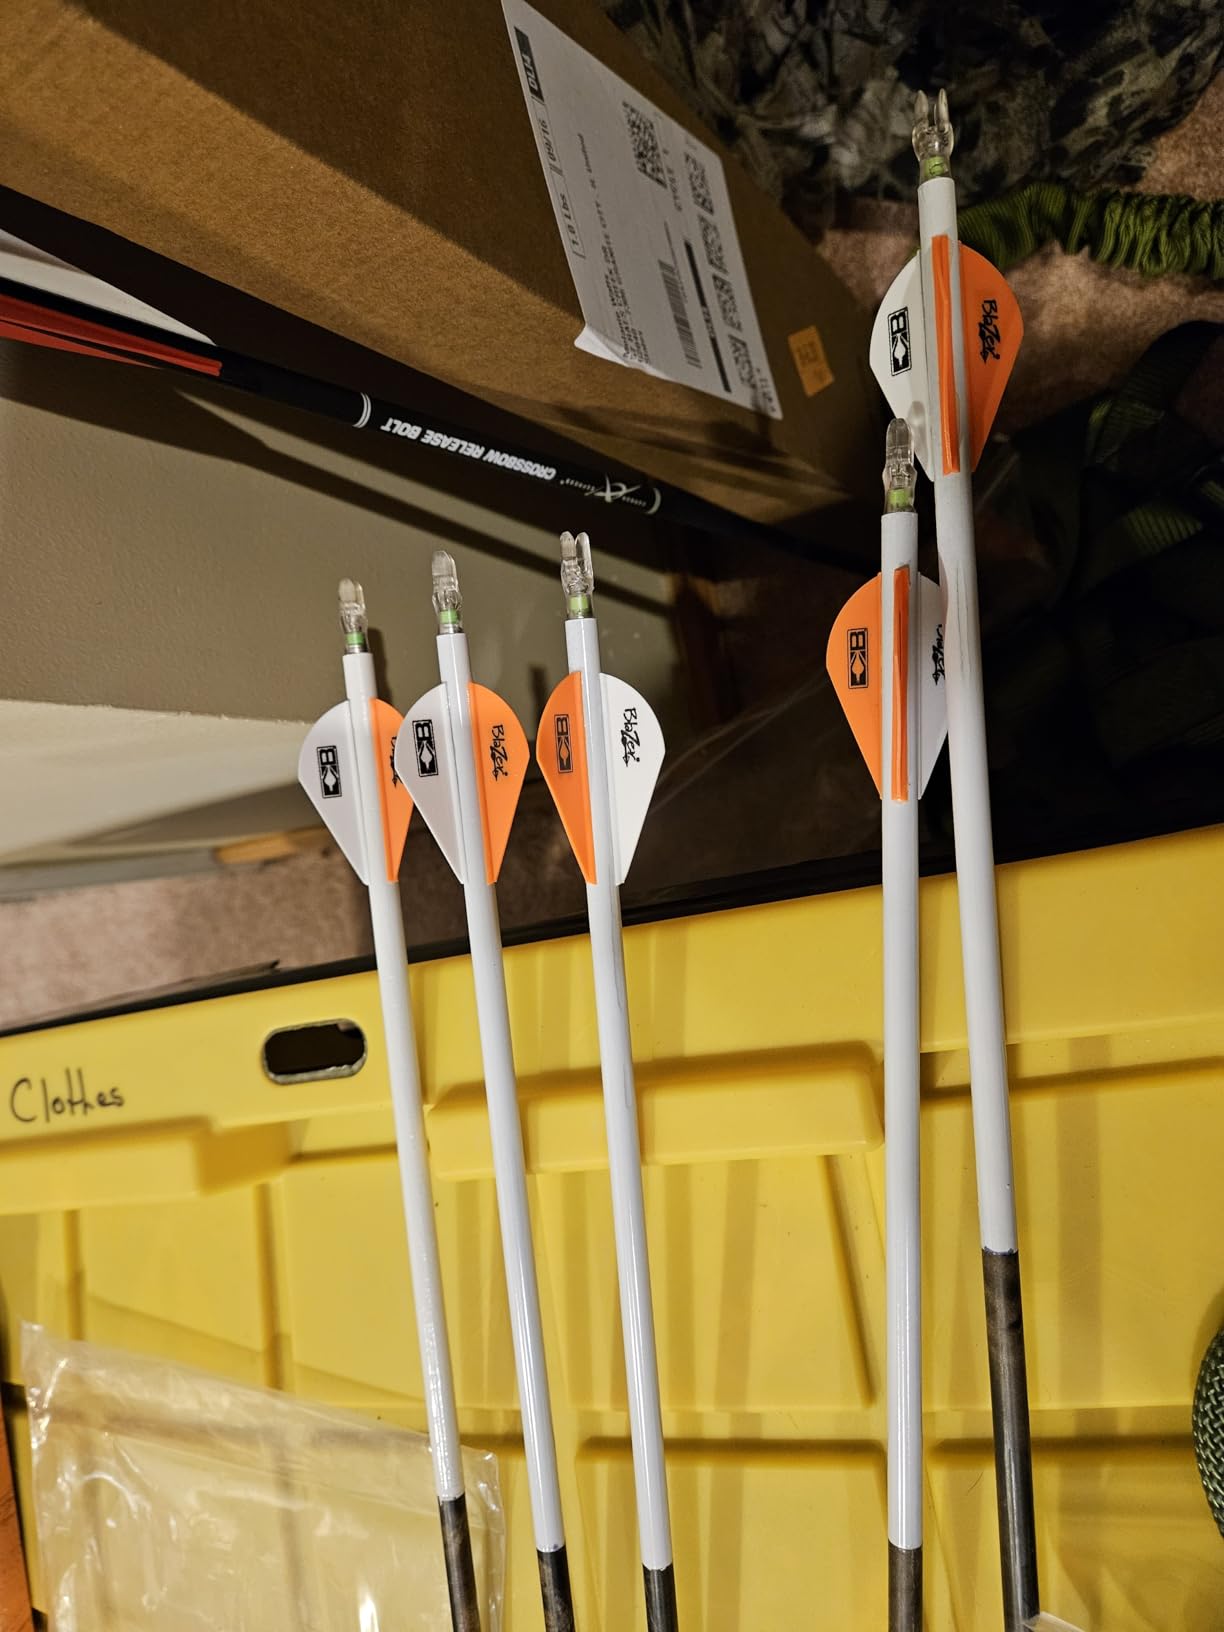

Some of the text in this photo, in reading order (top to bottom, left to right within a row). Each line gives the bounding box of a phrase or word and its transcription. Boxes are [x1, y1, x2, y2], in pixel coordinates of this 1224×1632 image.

[380, 417, 557, 480] CROSSBOW RELEASE BOLT
[9, 1066, 125, 1123] Clothes
